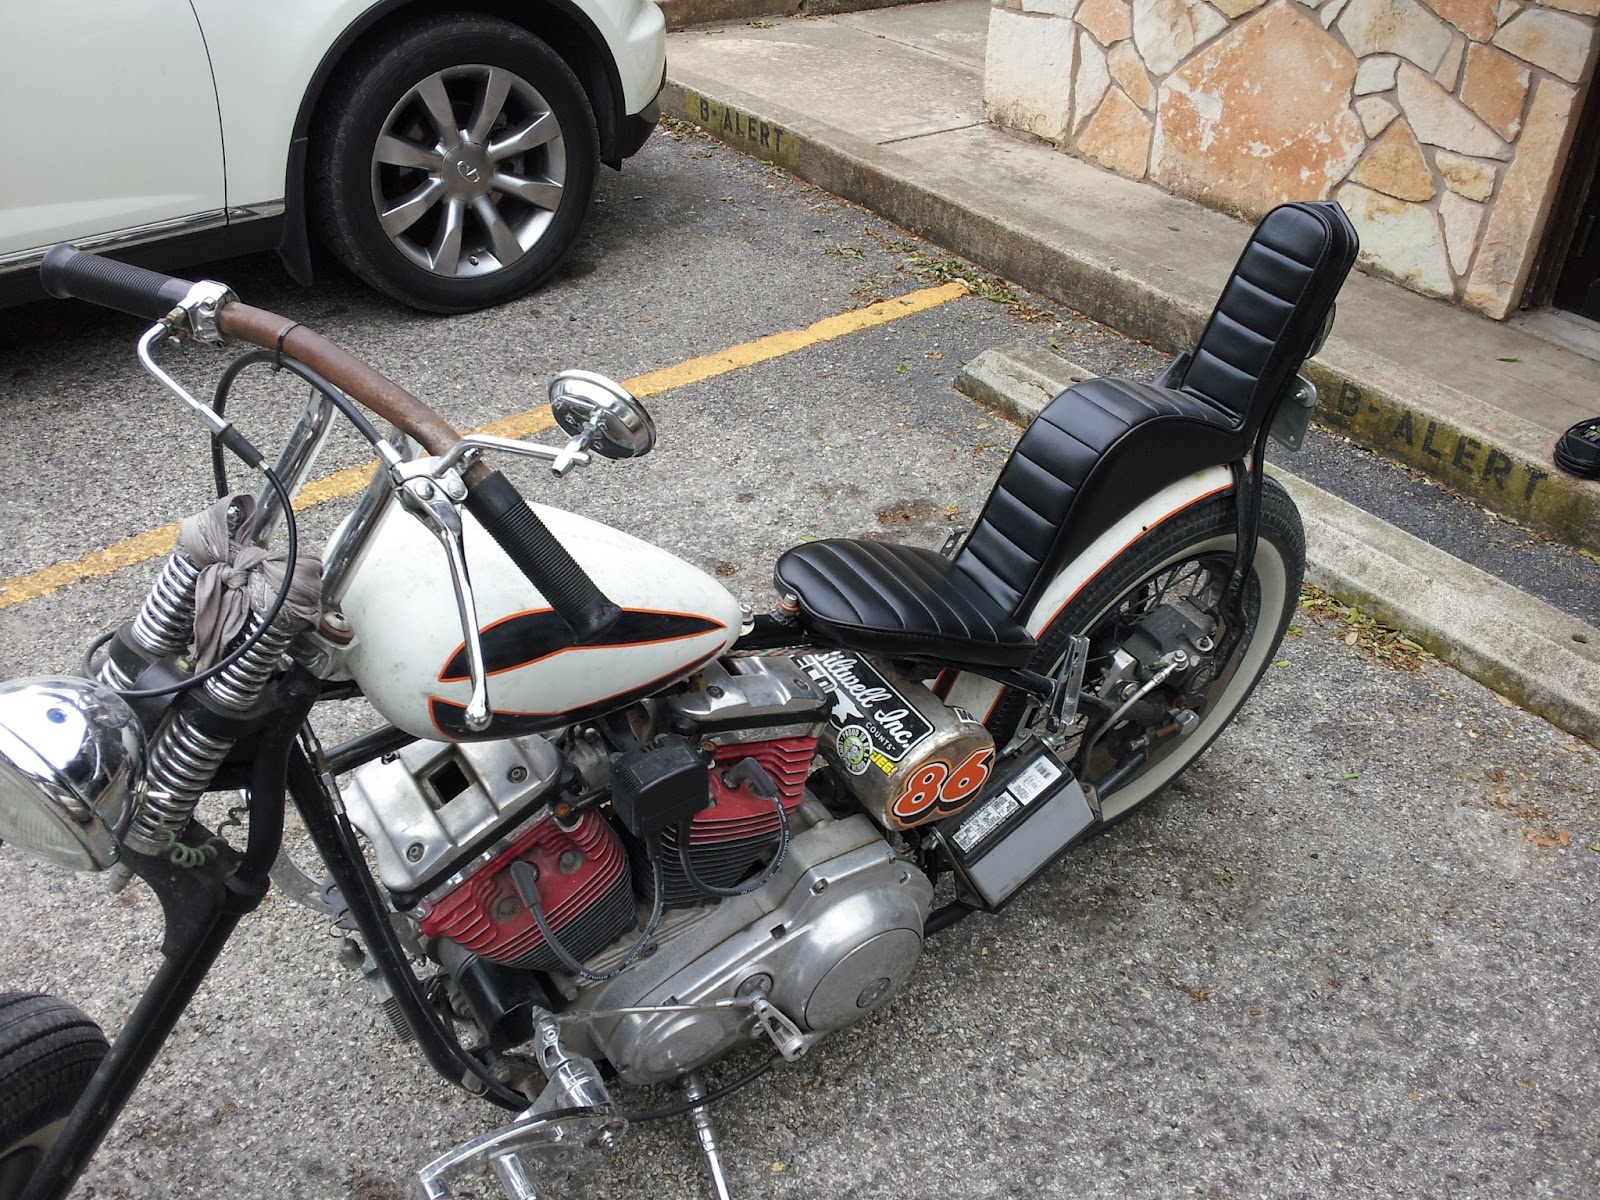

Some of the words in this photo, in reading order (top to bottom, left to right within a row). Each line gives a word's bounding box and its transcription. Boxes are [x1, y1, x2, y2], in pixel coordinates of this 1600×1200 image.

[699, 97, 784, 153] B-ALERT
[1335, 378, 1550, 502] B-ALERT
[889, 746, 995, 826] 86
